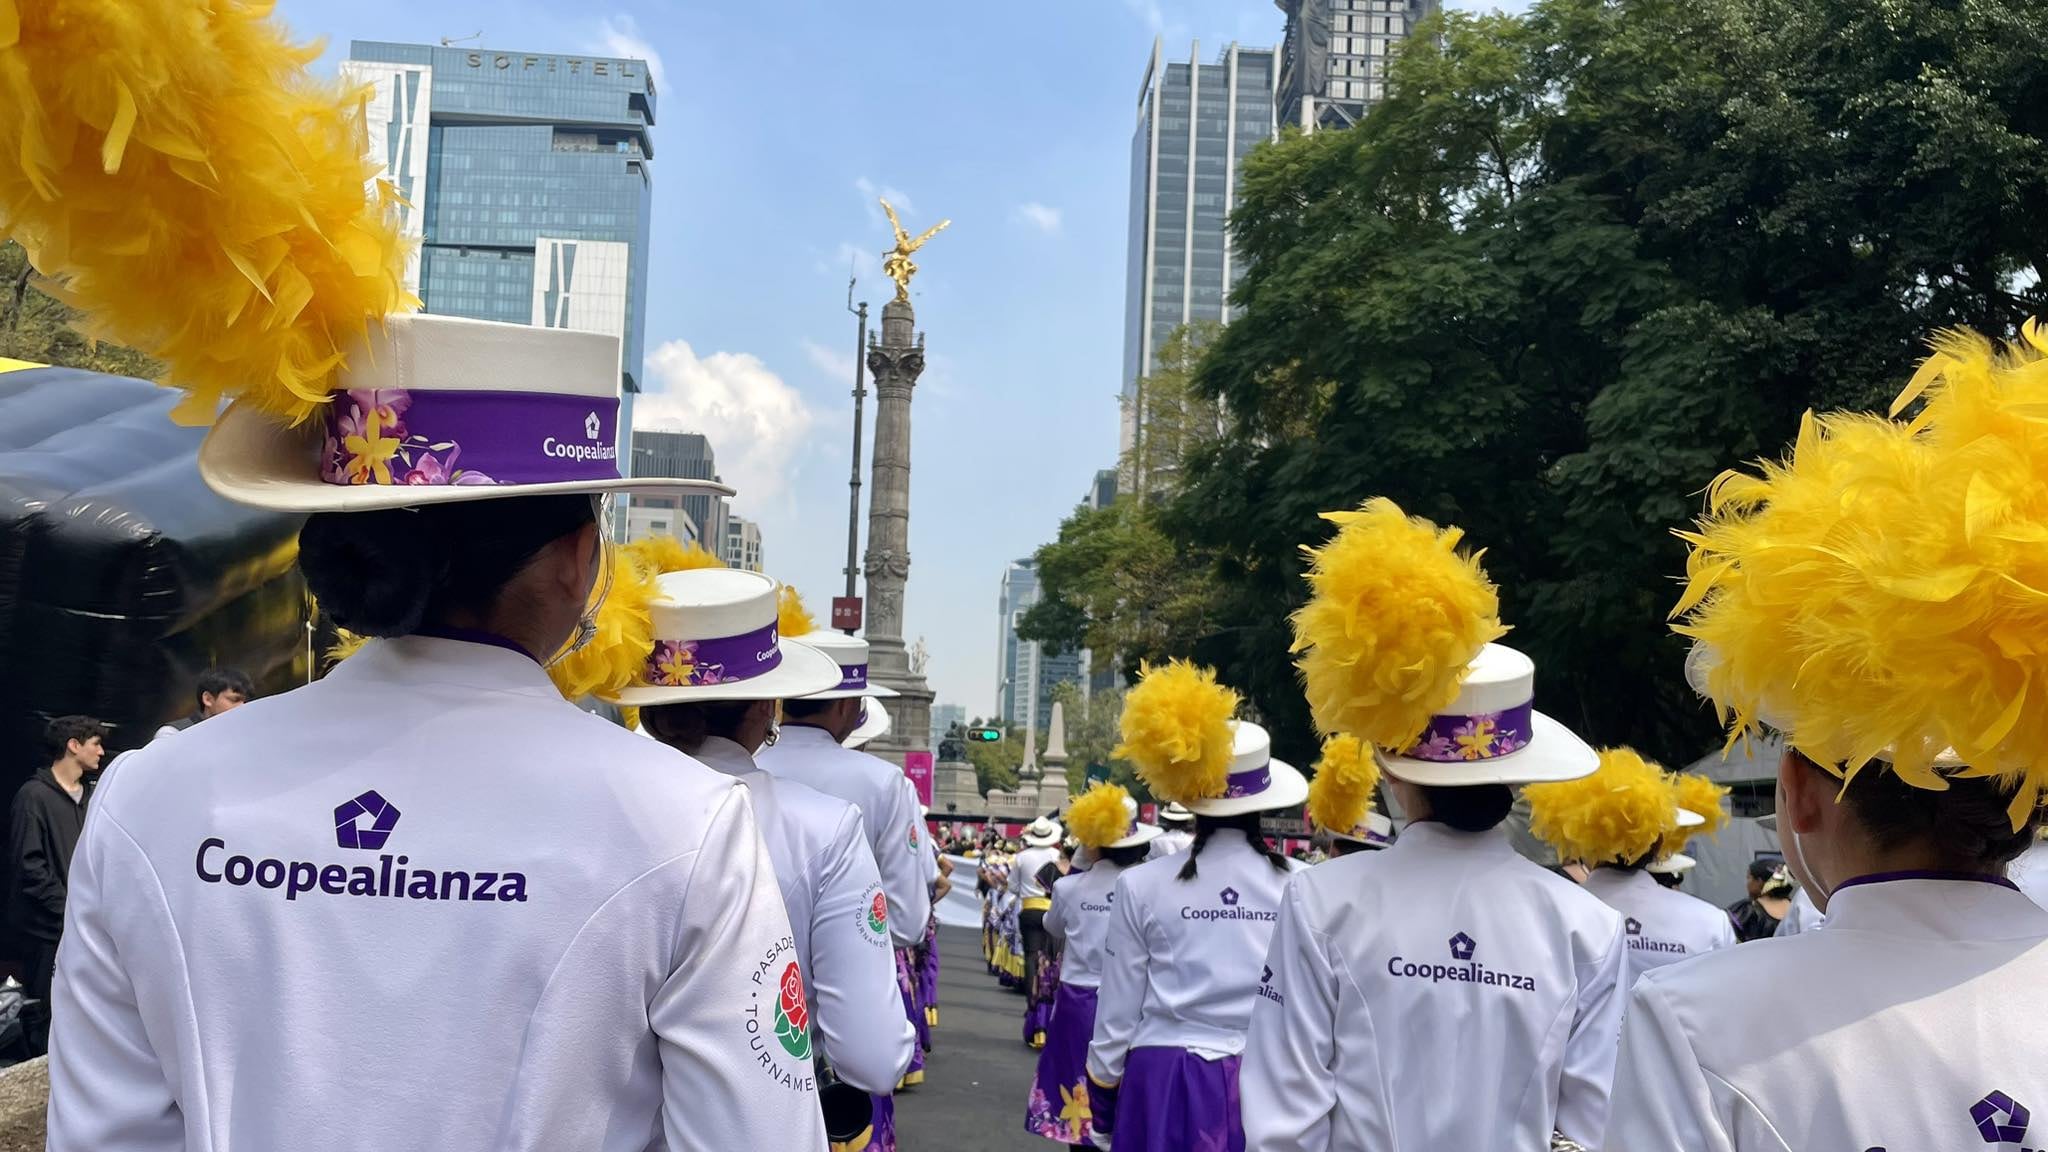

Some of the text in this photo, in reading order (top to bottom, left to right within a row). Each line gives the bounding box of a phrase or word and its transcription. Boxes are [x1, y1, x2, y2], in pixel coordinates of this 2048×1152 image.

[467, 53, 635, 78] SOFITEL
[196, 837, 528, 902] Coopealianza
[1387, 956, 1536, 992] Coopealianza
[745, 1004, 815, 1092] TOURNAME
